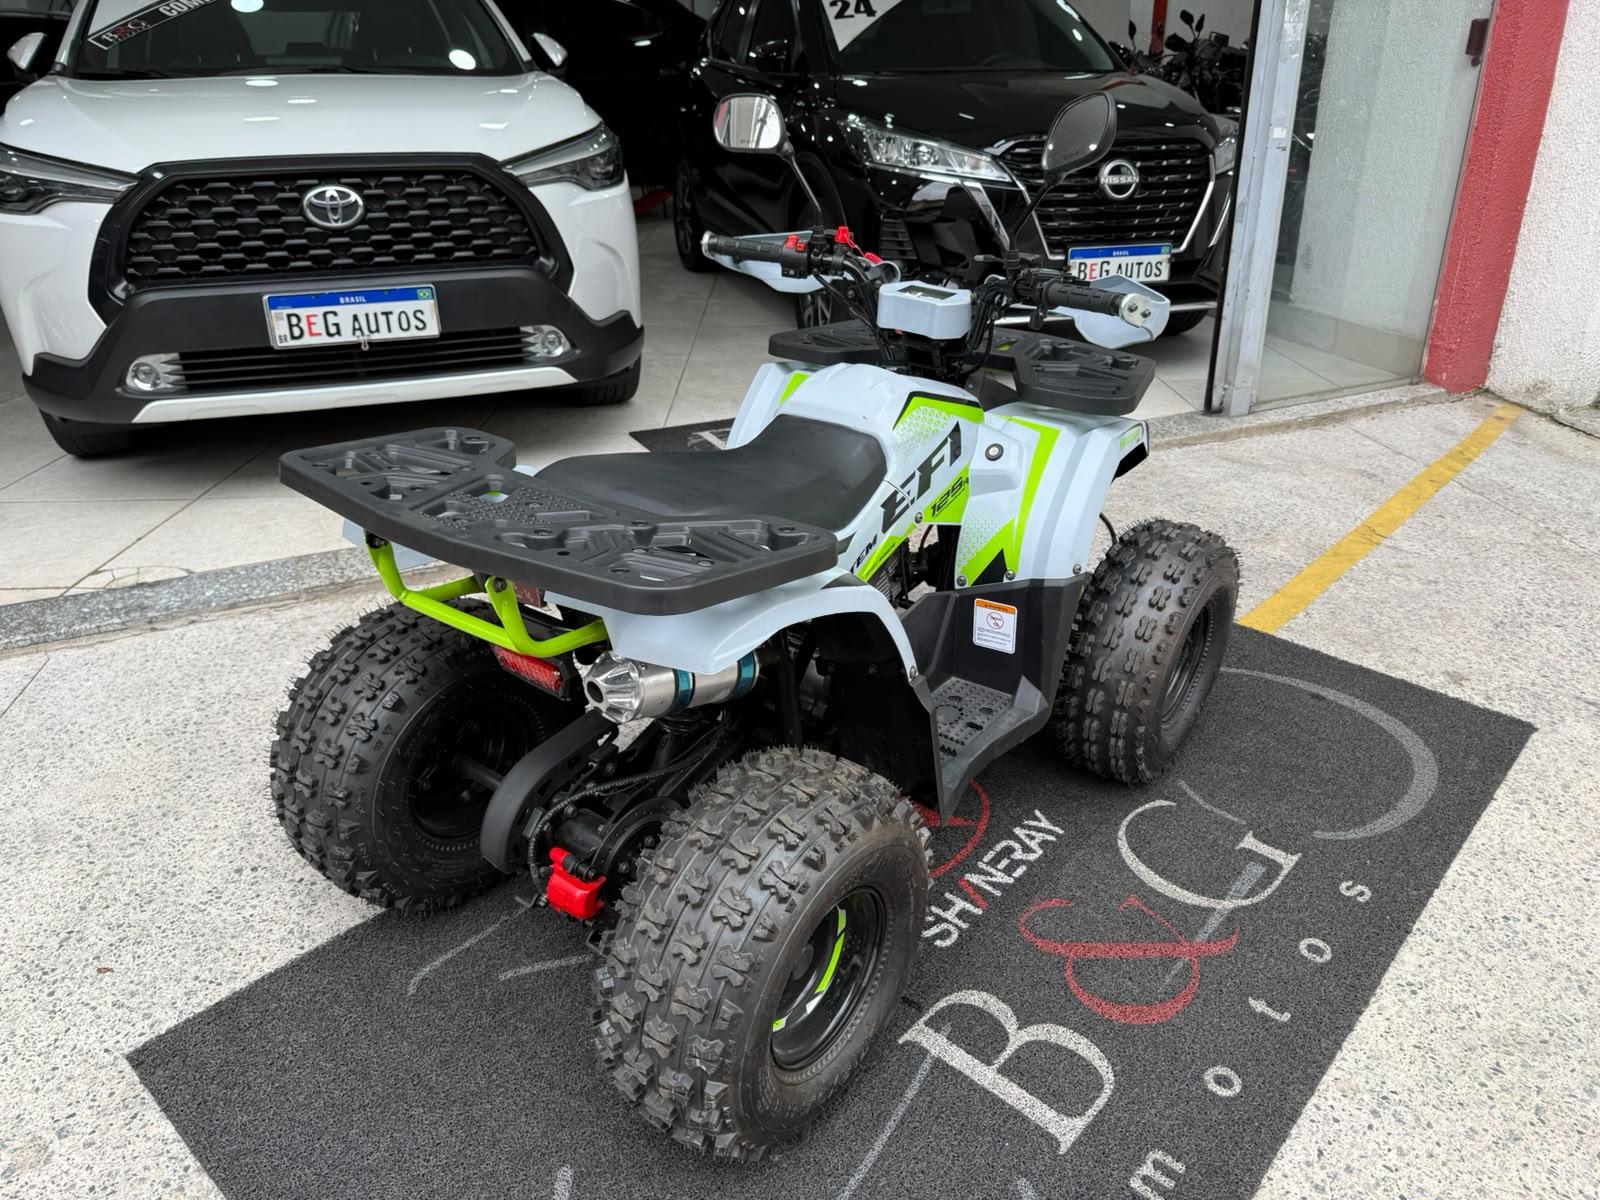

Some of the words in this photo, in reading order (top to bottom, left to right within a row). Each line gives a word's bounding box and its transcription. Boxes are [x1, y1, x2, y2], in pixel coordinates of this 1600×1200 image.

[158, 0, 213, 17] COM
[829, 0, 877, 20] 24
[1100, 174, 1139, 184] NISSAN
[1078, 260, 1110, 281] BEG
[1116, 261, 1163, 278] AUTOS
[339, 296, 367, 304] BRASIL
[286, 310, 342, 341] BEG
[352, 309, 427, 337] AUTOS
[898, 799, 1302, 1155] B&G
